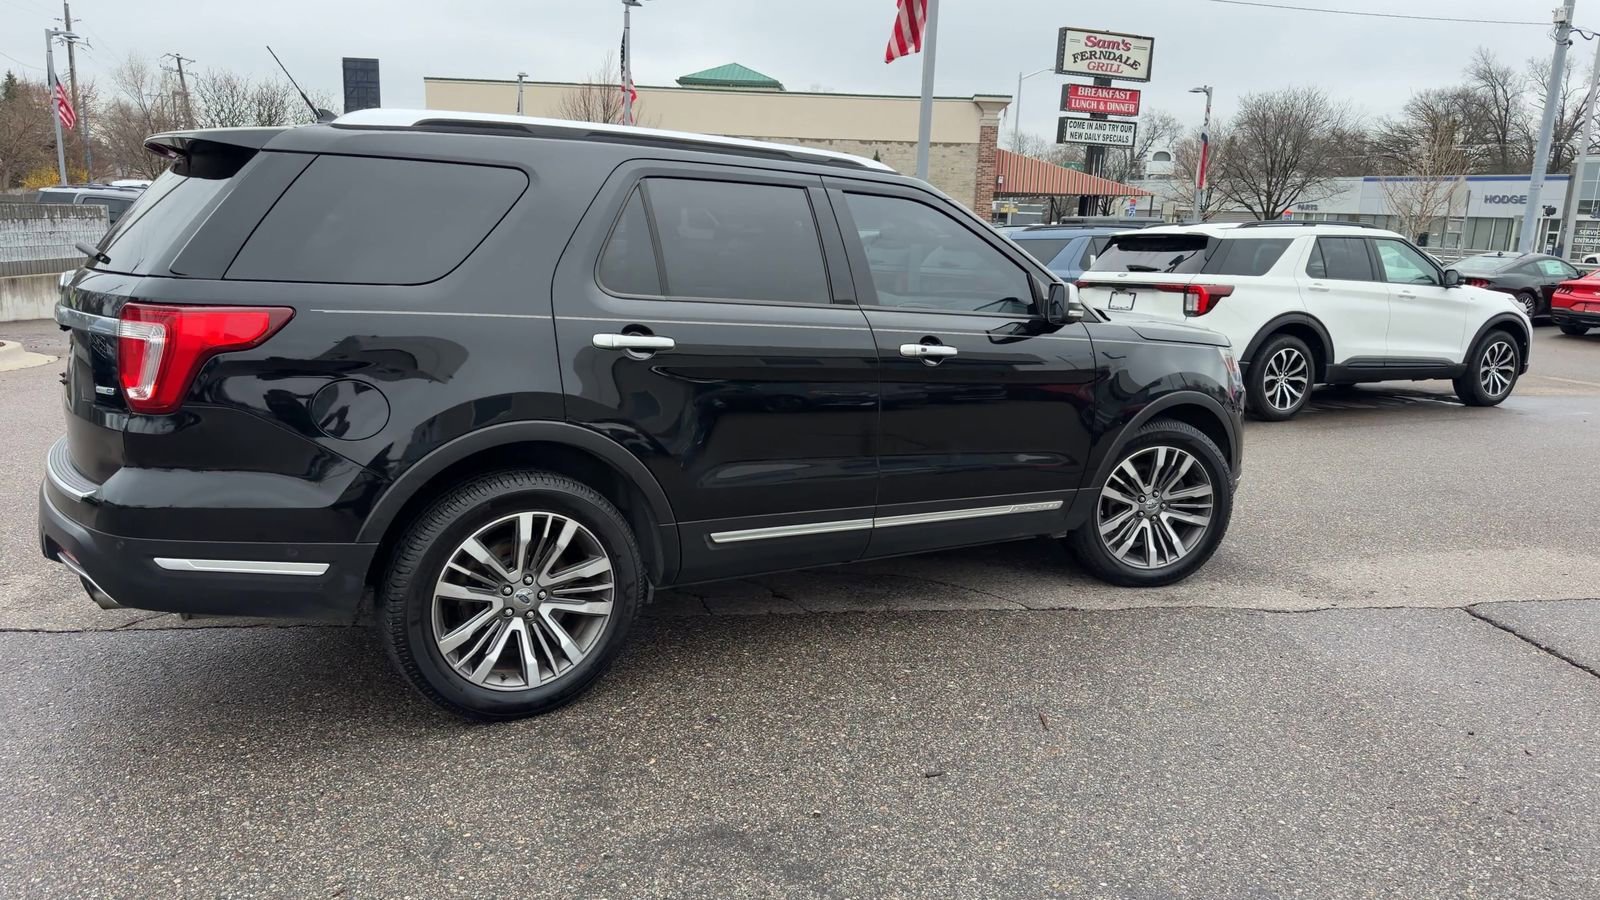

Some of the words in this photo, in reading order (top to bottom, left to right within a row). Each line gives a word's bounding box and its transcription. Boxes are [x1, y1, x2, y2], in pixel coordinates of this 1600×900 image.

[1084, 35, 1132, 51] Sam's
[1072, 50, 1141, 70] FERNDALE
[1087, 61, 1123, 73] GRILL
[1078, 87, 1132, 100] BREAKFAST
[1071, 98, 1097, 109] LUNCH
[1099, 101, 1105, 110] &
[1107, 102, 1135, 113] DINNER
[1068, 121, 1086, 129] COME
[1086, 122, 1094, 130] IN
[1094, 123, 1107, 131] AND
[1108, 124, 1120, 132] TRY
[1120, 125, 1133, 133] OUR
[1069, 132, 1084, 140] NEW
[1084, 133, 1101, 141] DAILY
[1101, 134, 1130, 143] SPECIALS
[1484, 195, 1527, 204] HODGE
